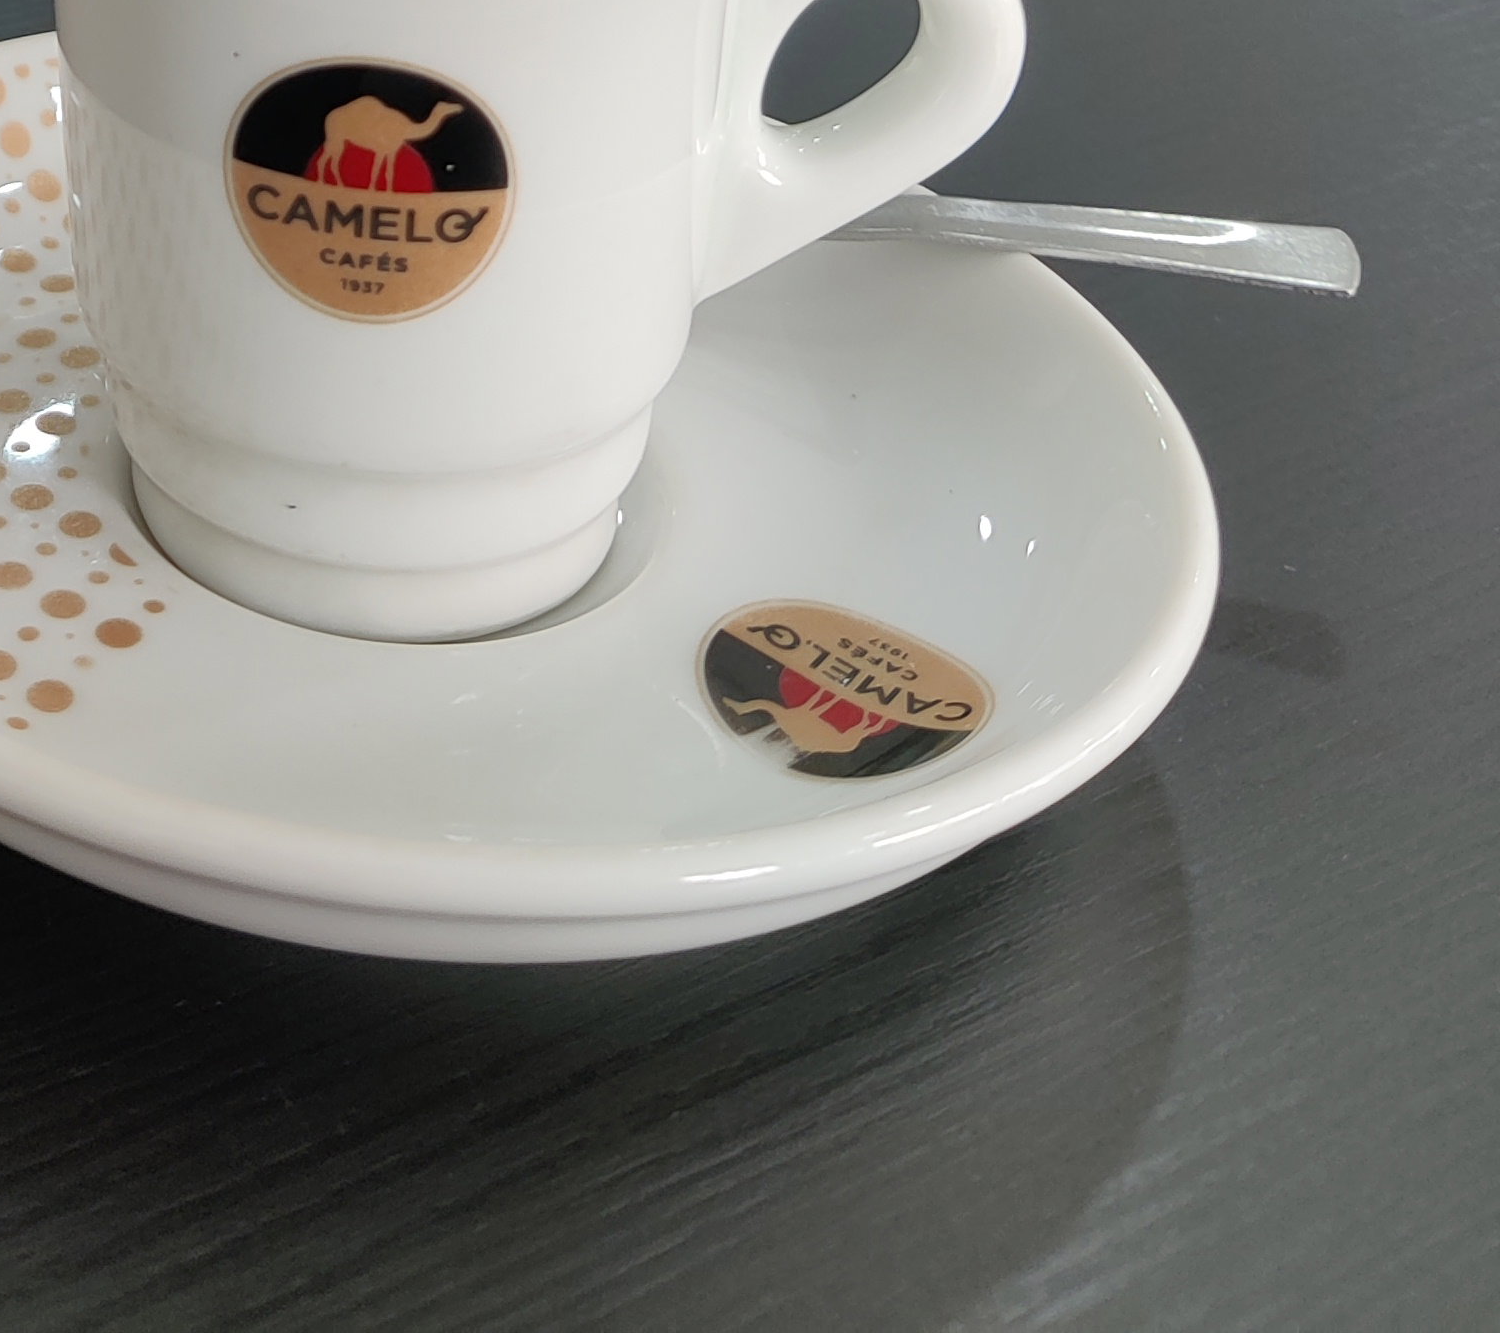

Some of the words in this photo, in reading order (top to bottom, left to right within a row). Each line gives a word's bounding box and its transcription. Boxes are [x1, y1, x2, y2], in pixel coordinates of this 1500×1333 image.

[247, 184, 489, 243] CAMELO
[319, 247, 409, 273] CAFÉS
[340, 277, 385, 295] 1937
[746, 624, 973, 722] CAMELO
[837, 636, 918, 682] CAFÉS
